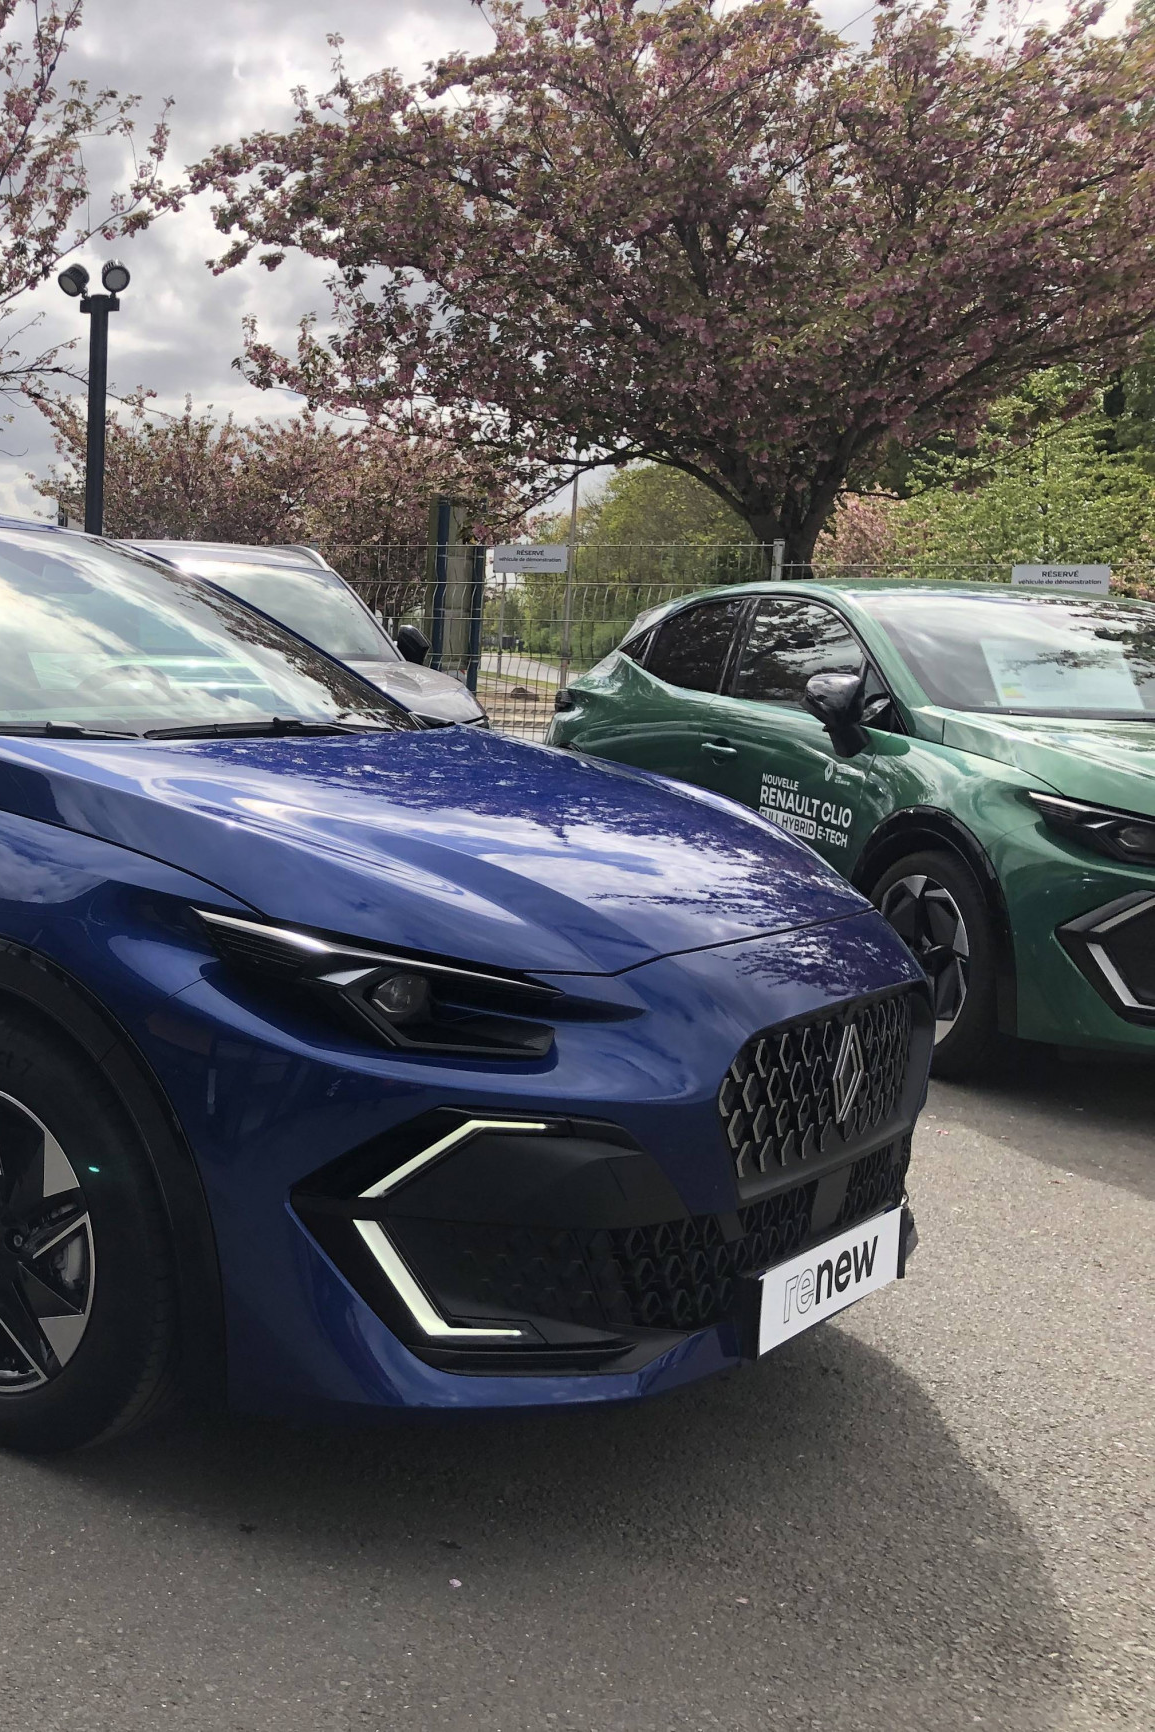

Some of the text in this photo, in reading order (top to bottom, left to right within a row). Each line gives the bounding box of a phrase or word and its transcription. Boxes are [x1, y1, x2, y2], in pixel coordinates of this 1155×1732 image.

[1041, 569, 1080, 578] RÉSERVÉ
[761, 772, 800, 792] NOUVELLE
[759, 785, 853, 829] RENAULT CLIO
[781, 814, 815, 836] HYBRID
[816, 825, 849, 848] E-TECH
[782, 1234, 879, 1324] renew
